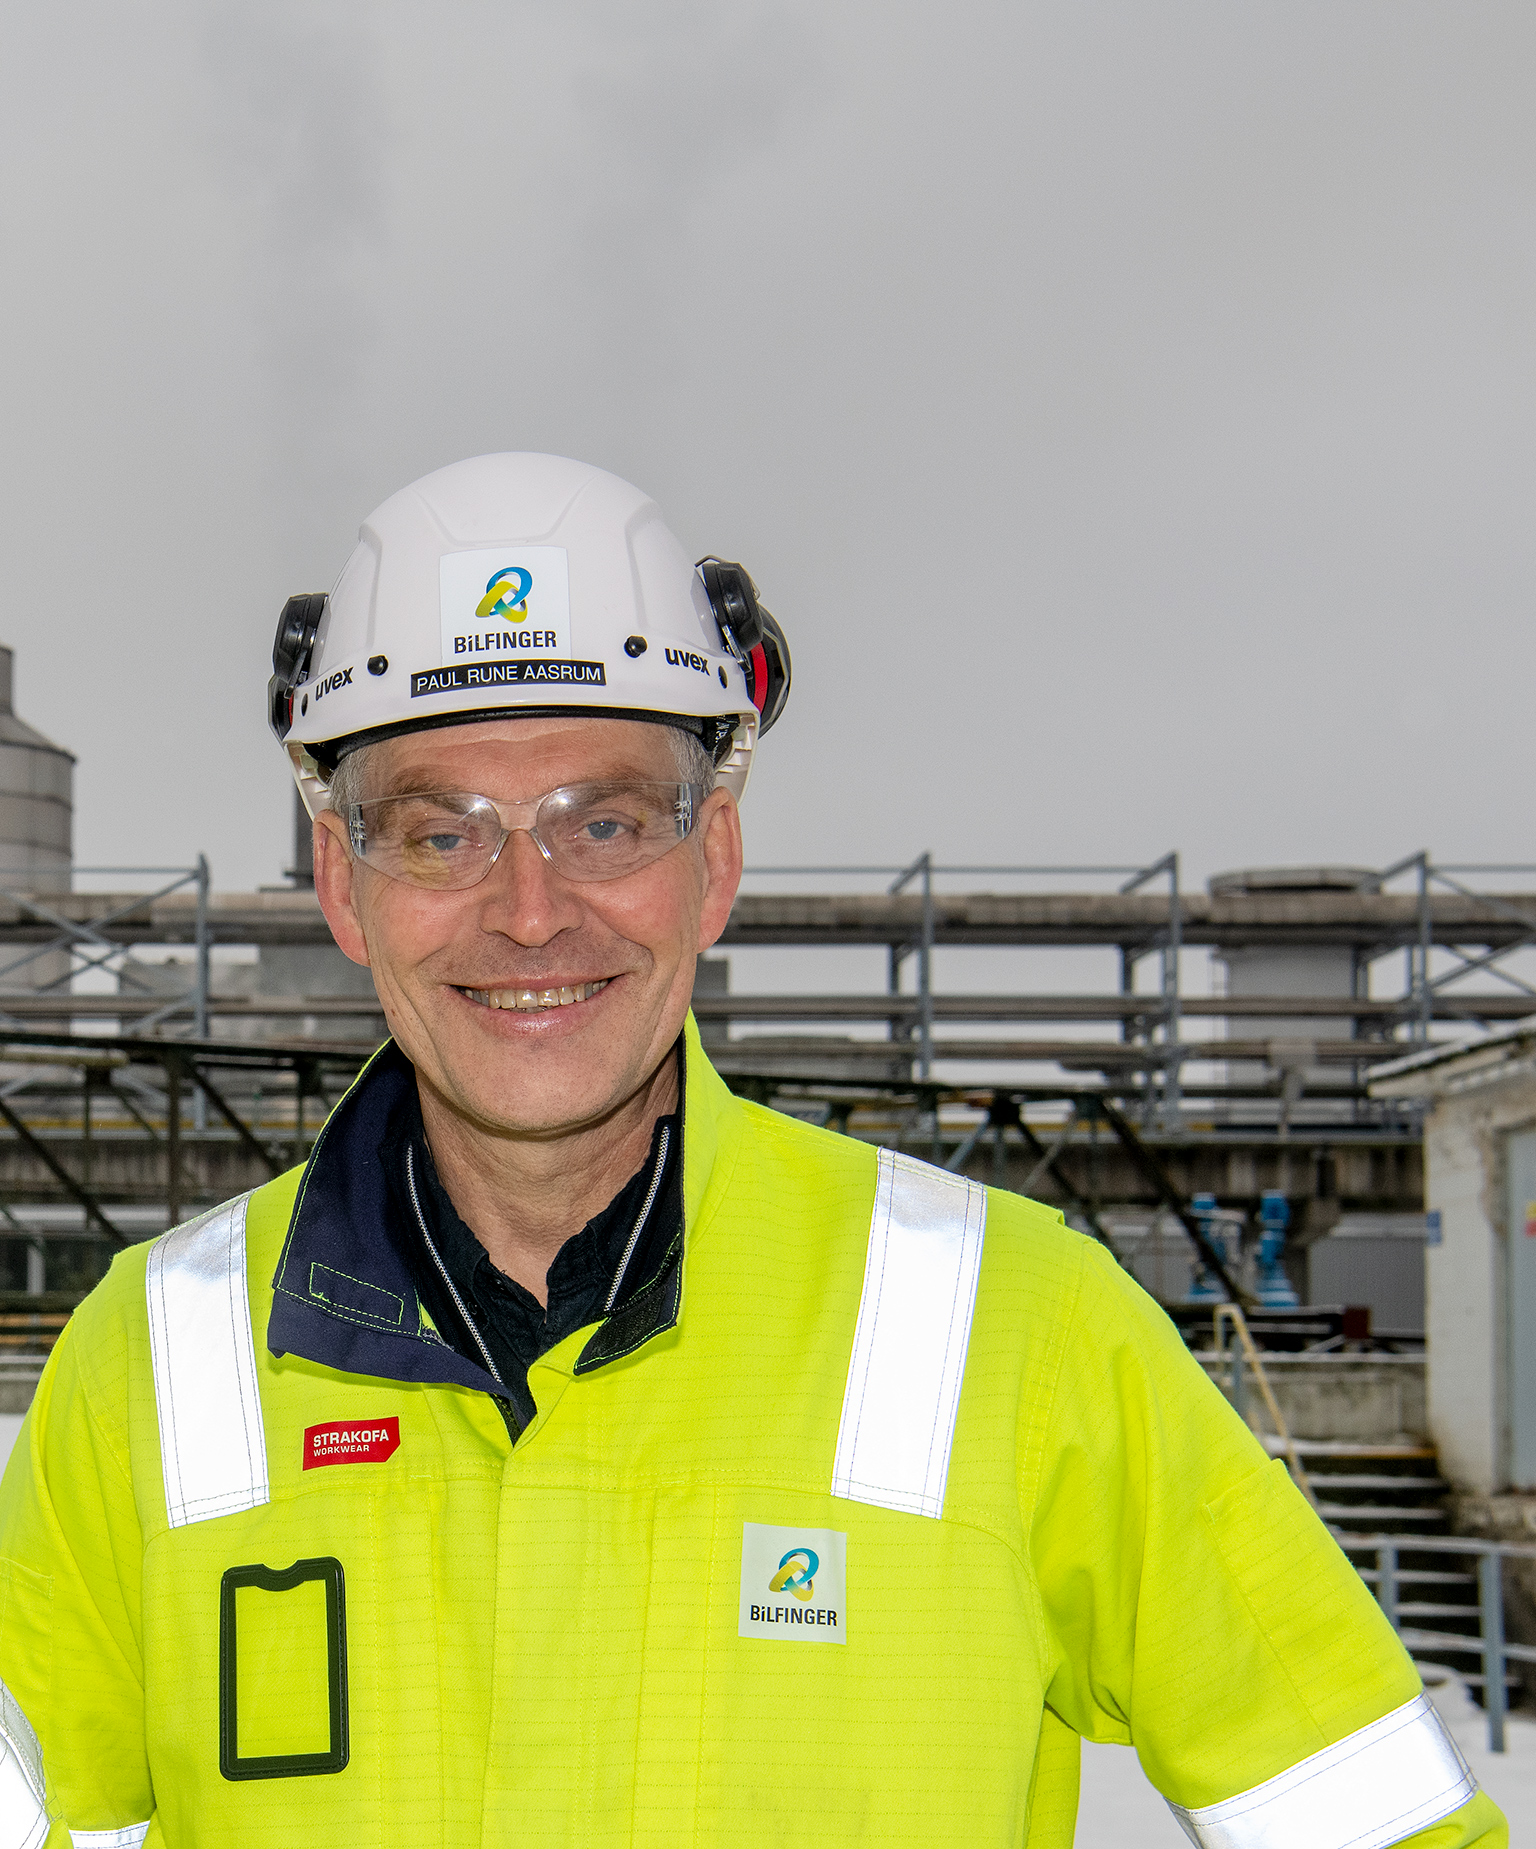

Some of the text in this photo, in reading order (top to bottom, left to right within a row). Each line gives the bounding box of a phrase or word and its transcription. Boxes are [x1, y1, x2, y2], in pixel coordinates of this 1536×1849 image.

[454, 630, 557, 654] BiLFINGER
[665, 647, 710, 676] uvex
[315, 666, 355, 701] uvex
[417, 661, 602, 691] PAUL RUNE AASRUM
[313, 1429, 389, 1448] STRAKOFA
[313, 1444, 370, 1457] WORKWEAR
[750, 1605, 838, 1627] BiLFINGER
